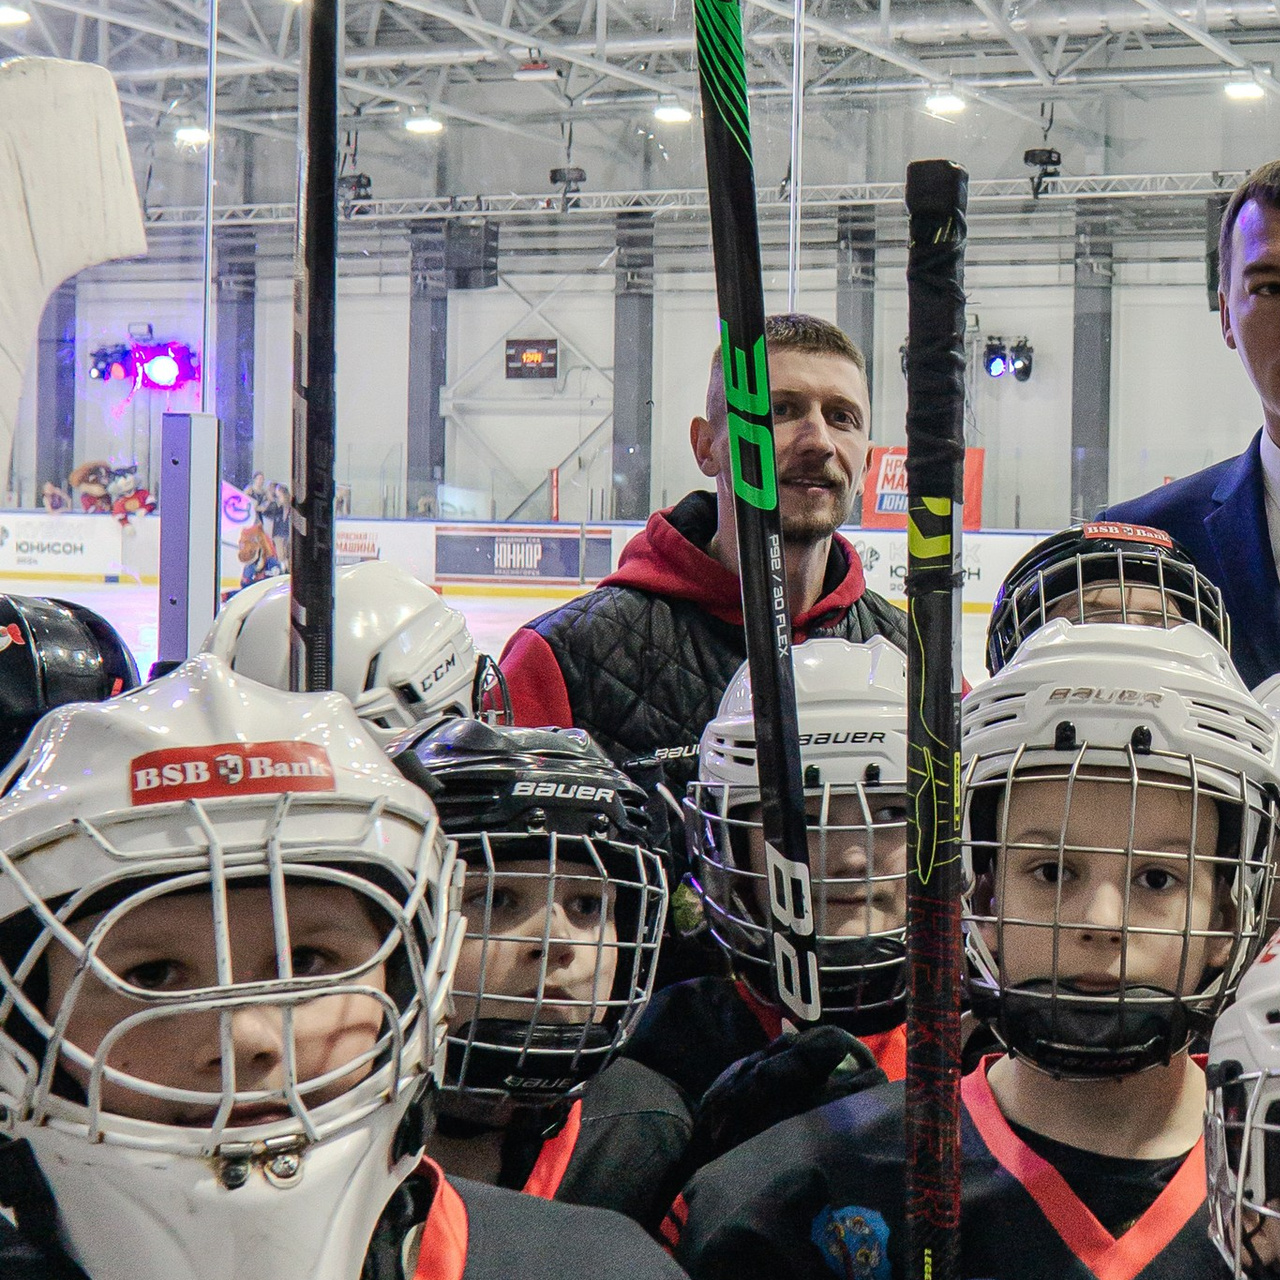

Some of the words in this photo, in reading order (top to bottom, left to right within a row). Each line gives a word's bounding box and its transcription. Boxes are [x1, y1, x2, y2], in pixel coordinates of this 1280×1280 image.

[16, 540, 84, 555] ЮНИСОН
[1087, 524, 1120, 535] BSB
[1136, 528, 1172, 543] Bank
[769, 534, 780, 571] P92
[773, 584, 785, 612] 30
[776, 613, 789, 658] FLEX
[420, 653, 456, 693] CCM
[1045, 687, 1164, 708] BAUER
[134, 761, 211, 791] BSB
[246, 756, 330, 779] Bank
[511, 780, 616, 804] BAUER
